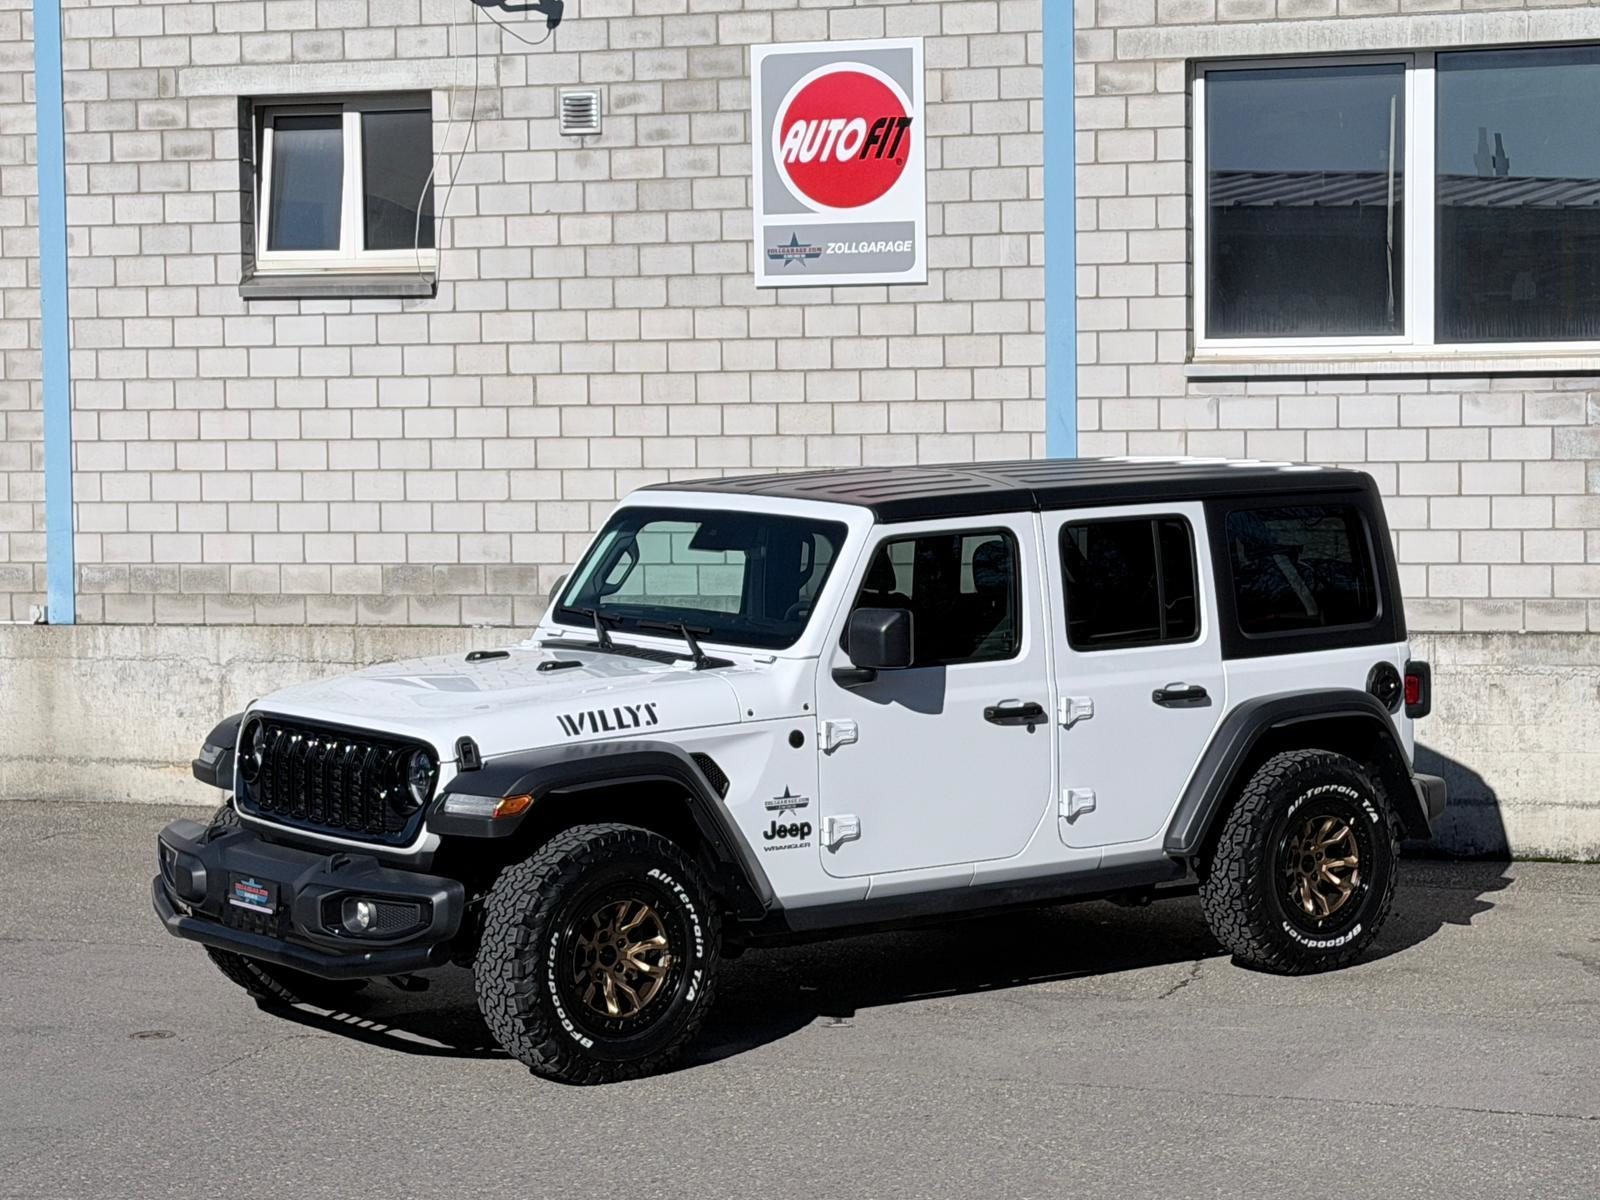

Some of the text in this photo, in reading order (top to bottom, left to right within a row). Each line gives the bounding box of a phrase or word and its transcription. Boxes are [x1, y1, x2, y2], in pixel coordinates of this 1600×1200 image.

[781, 117, 913, 163] AUTOFIT
[826, 240, 913, 254] ZOLLGARAGE
[556, 702, 659, 737] WILLYS
[1287, 784, 1379, 823] All-Terrain T/A
[763, 820, 812, 840] Jeep
[763, 842, 811, 852] WRANGLER
[647, 868, 704, 1001] All-Terrain T/A
[1282, 920, 1362, 948] BFGoodrich
[547, 932, 594, 1048] BFGoodrich
